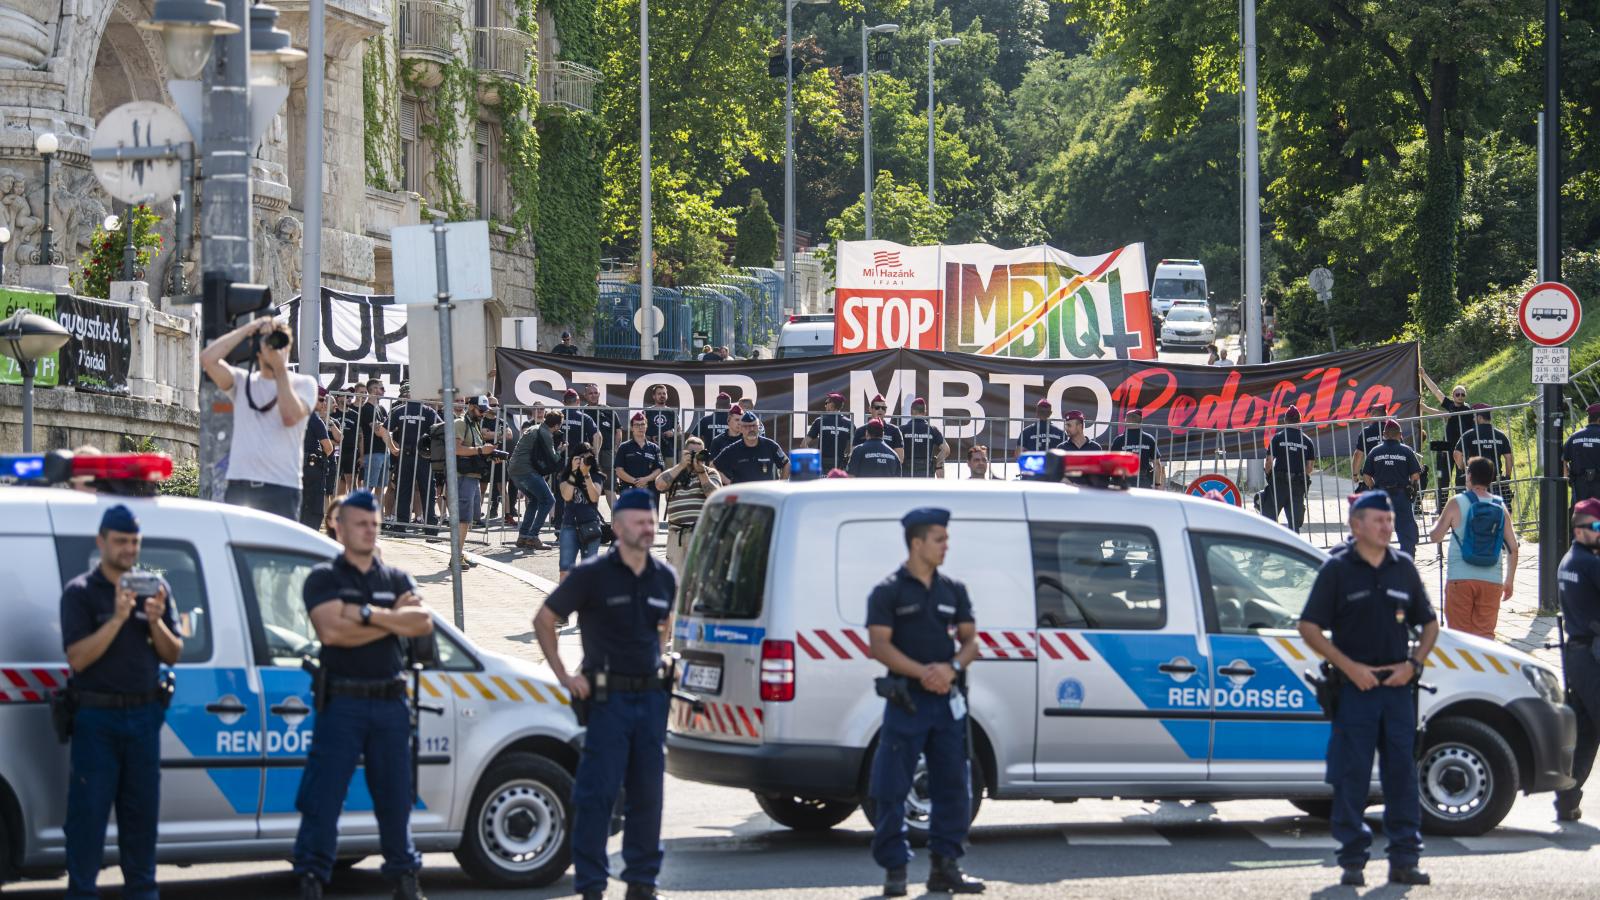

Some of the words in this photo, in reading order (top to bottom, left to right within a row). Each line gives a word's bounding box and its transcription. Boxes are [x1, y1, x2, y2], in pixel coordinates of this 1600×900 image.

[863, 268, 874, 277] Mi
[880, 268, 915, 278] Hazánk
[842, 296, 935, 350] STOP
[514, 367, 758, 438] STOP
[1112, 367, 1401, 449] Pedofília
[1168, 683, 1304, 709] RENDŐRSÉG
[426, 736, 449, 752] 112
